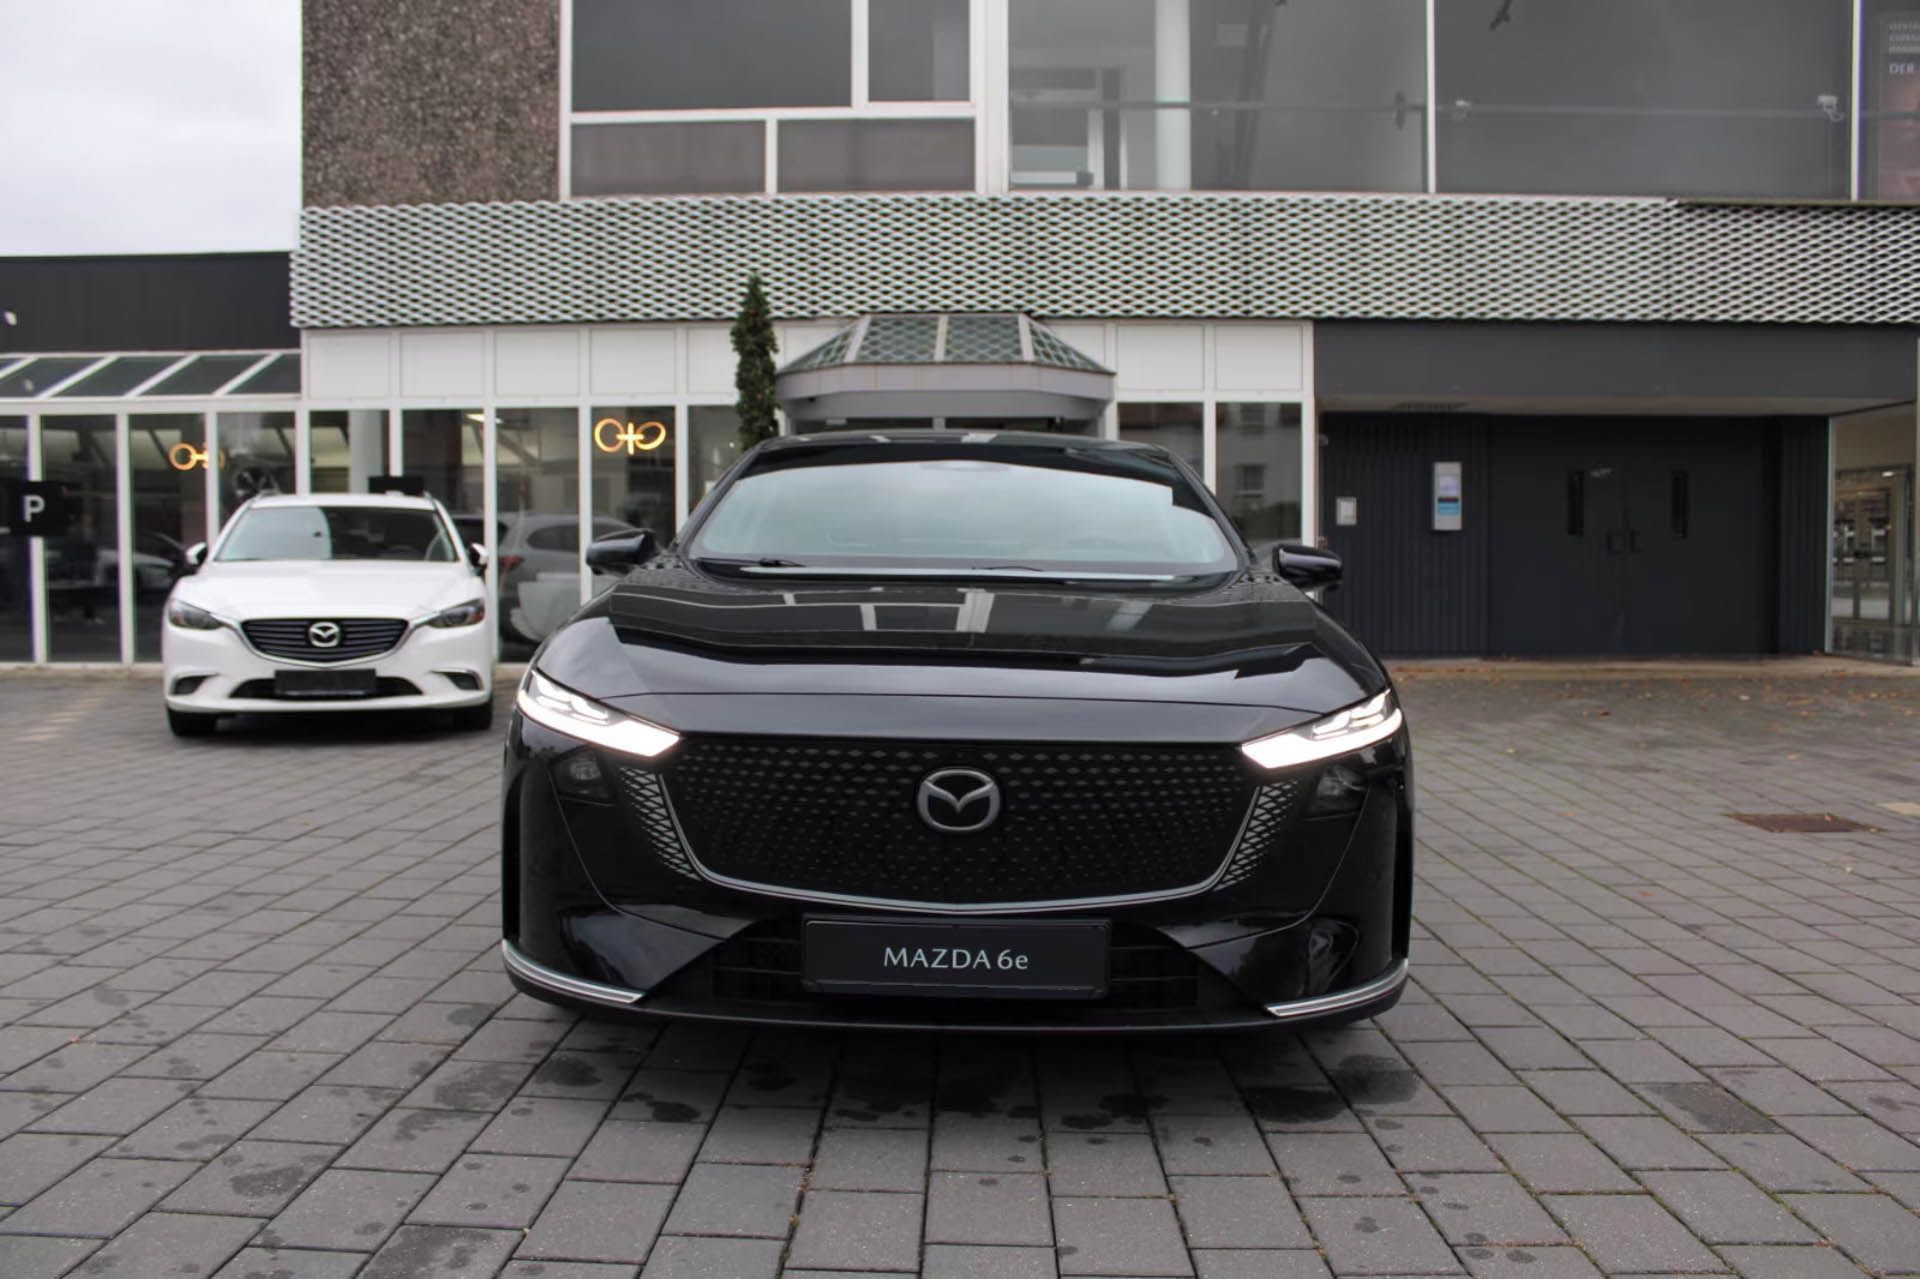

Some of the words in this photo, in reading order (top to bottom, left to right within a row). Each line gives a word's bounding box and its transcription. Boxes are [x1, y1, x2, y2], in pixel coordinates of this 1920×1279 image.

[23, 495, 45, 523] P
[884, 947, 991, 969] MAZDA
[997, 949, 1029, 970] 6e
